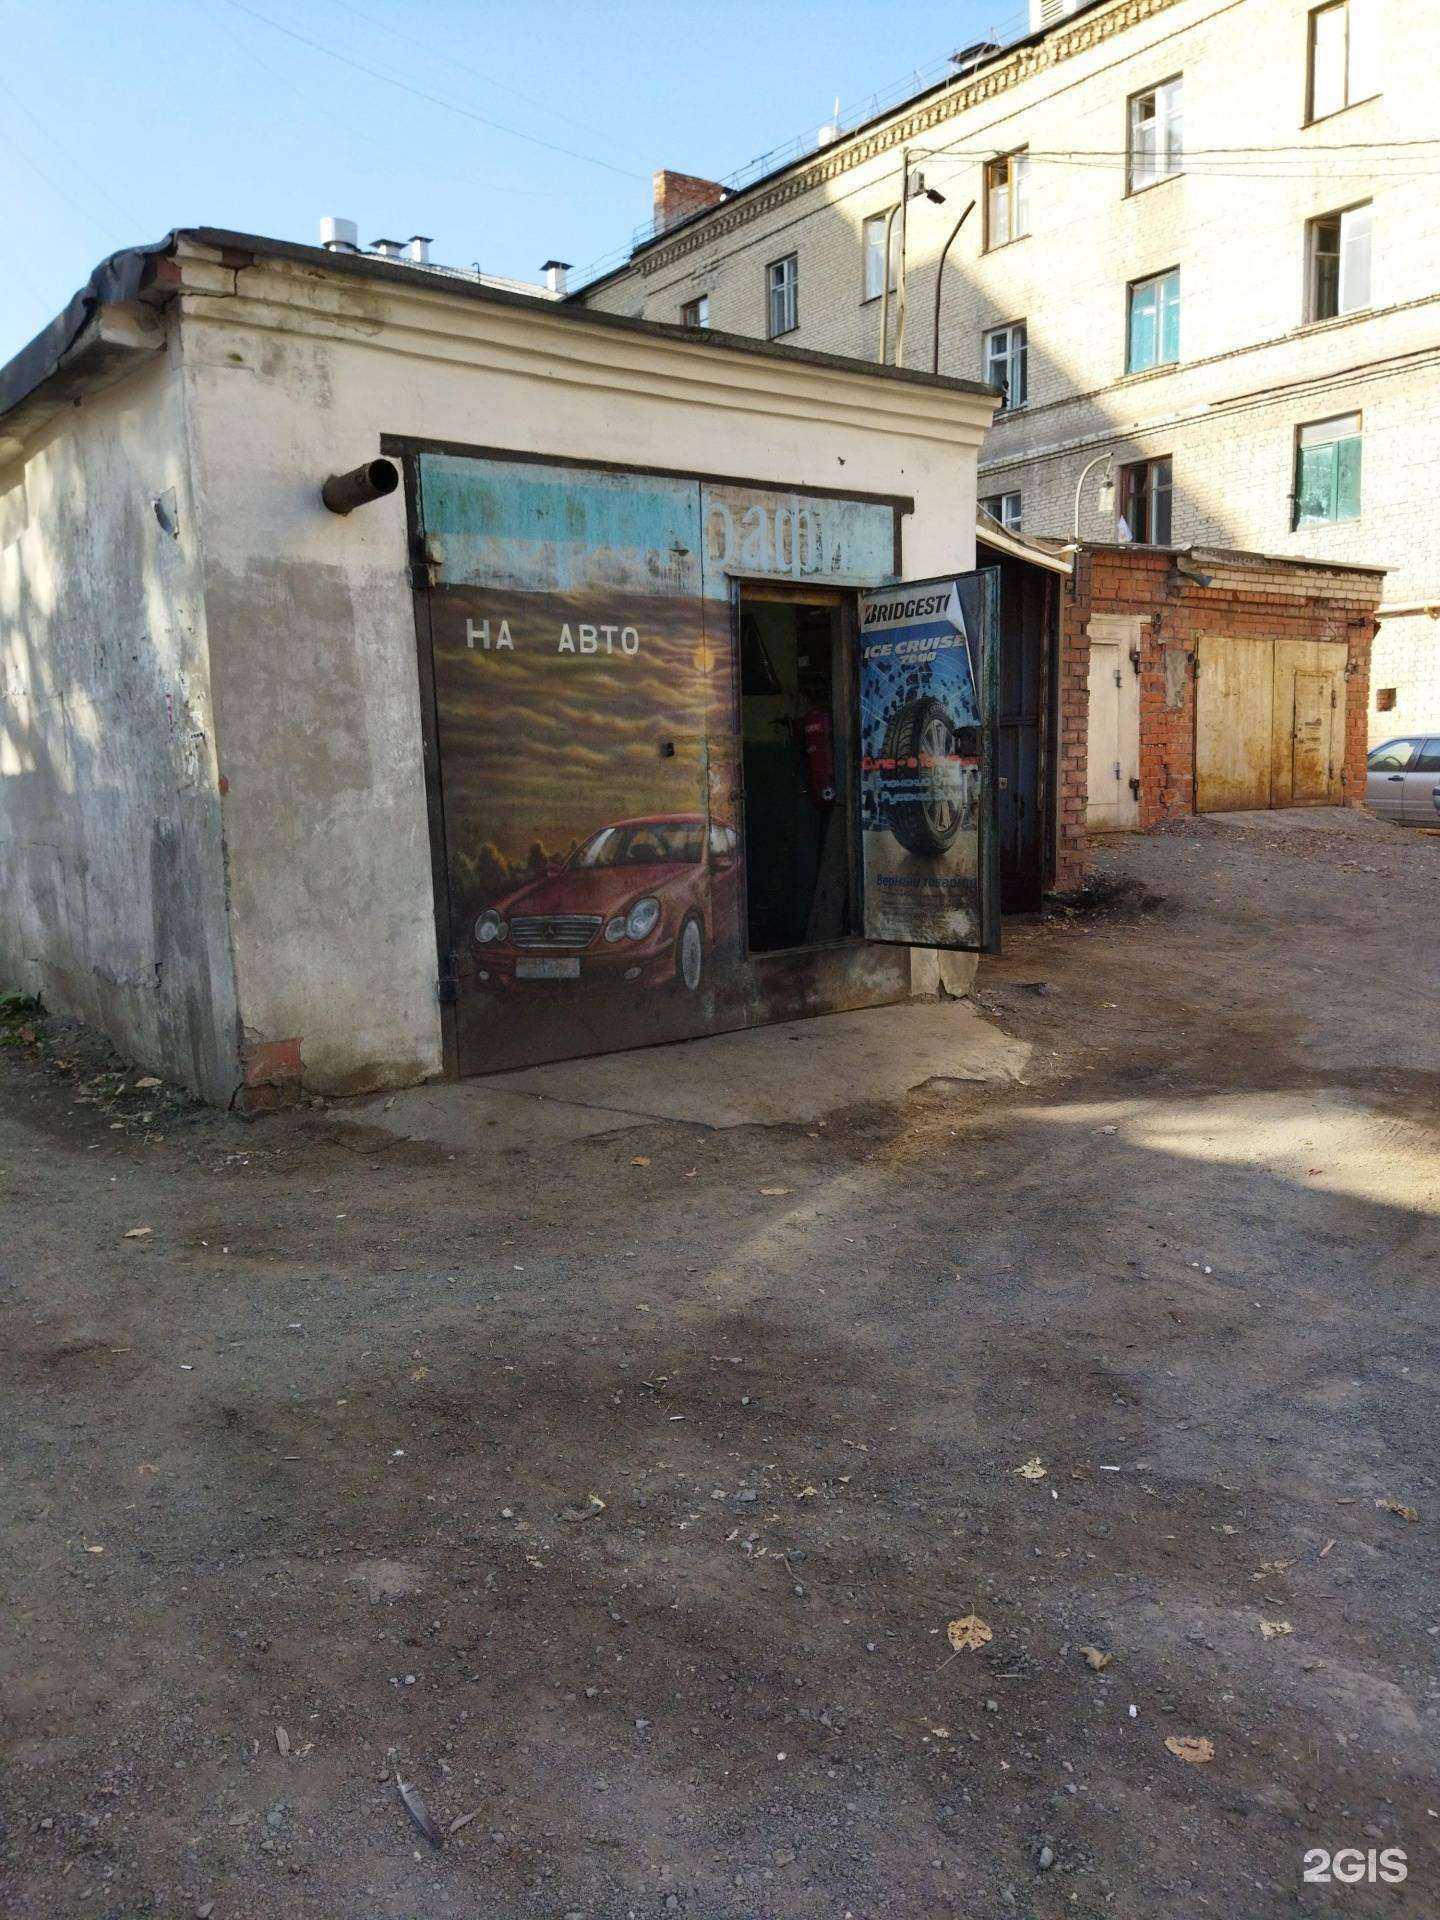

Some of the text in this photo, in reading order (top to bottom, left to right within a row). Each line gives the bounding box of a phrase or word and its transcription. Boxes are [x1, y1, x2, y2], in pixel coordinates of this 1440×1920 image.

[465, 618, 640, 656] НА АВТО
[864, 643, 893, 659] ICE
